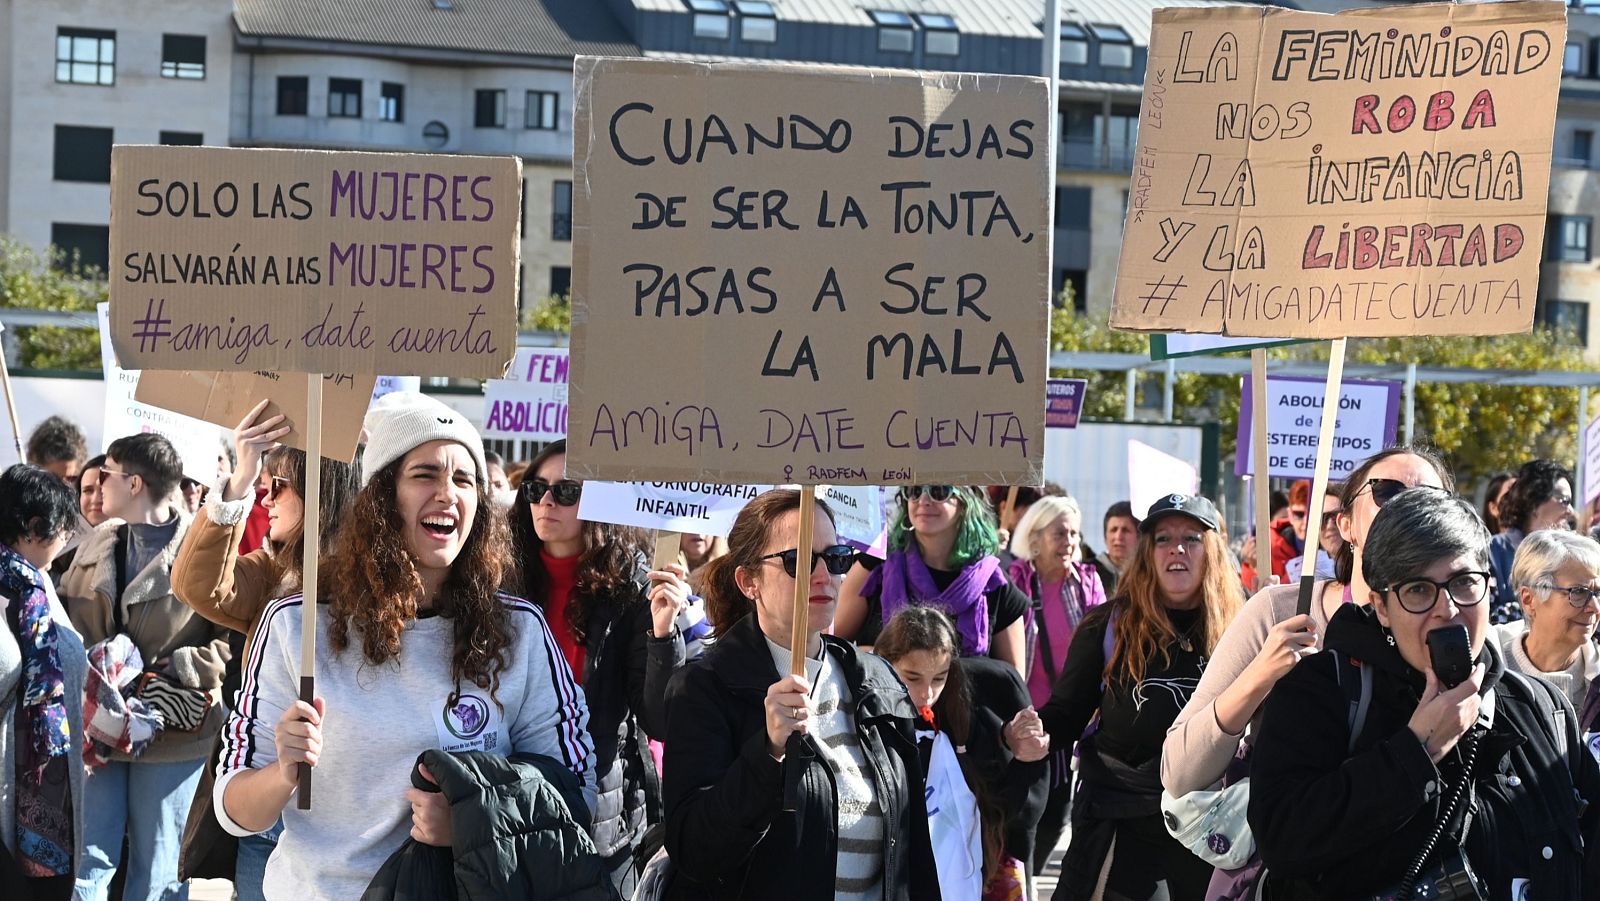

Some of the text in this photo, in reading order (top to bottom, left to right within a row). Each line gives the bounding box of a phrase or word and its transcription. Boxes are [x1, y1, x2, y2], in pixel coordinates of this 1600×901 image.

[1173, 31, 1239, 84] LA
[609, 102, 1035, 166] CUANDO DEJAS
[1216, 89, 1497, 141] NOS ROBA
[136, 169, 494, 222] SOLO LAS MUJERES
[1181, 153, 1256, 207] LA
[632, 181, 1035, 244] DE SER LA TONTA,
[124, 242, 496, 293] SALVARÁN A LAS MUJERES
[1153, 217, 1195, 263] Y
[1203, 225, 1265, 272] LA
[622, 263, 991, 322] PASAS A SER
[132, 299, 497, 364] #amiga, date cuenta
[761, 329, 1025, 384] LA MALA
[527, 354, 569, 383] FEM
[1279, 394, 1361, 410] ABOLIÓN
[1295, 415, 1341, 429] de ls
[757, 408, 864, 454] DATE
[886, 409, 1028, 458] CUENTA
[1267, 433, 1371, 450] STERETIPOS
[806, 465, 911, 481] RADFEM LEÓN
[1269, 454, 1354, 471] DE GÉRO
[636, 497, 710, 520] INFANTIL
[640, 480, 758, 500] ORNOGRAFIA
